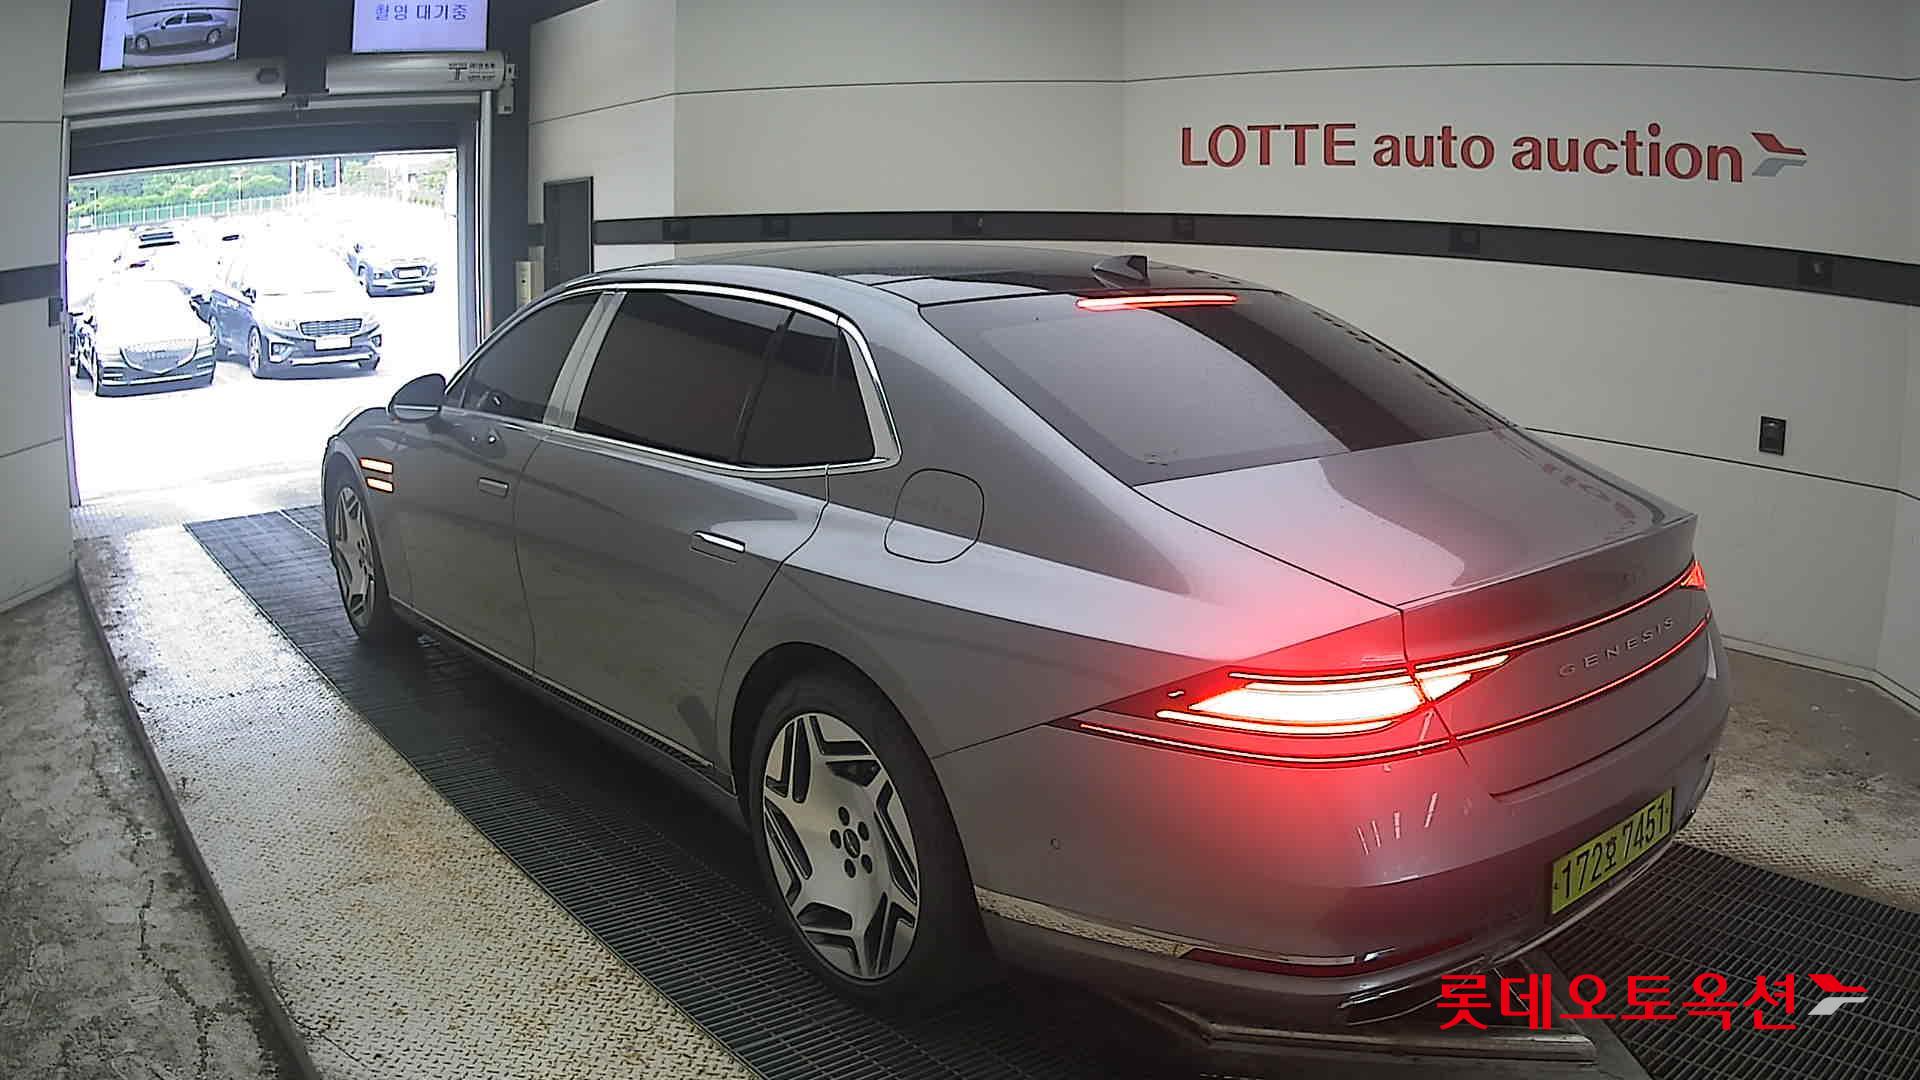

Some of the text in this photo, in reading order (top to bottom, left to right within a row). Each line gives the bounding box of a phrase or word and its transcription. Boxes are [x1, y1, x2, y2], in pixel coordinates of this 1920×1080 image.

[416, 4, 467, 21] 대기중
[1181, 123, 1744, 183] LOTTE auto auction
[1558, 616, 1674, 678] GENESIS
[1622, 797, 1665, 860] 7451
